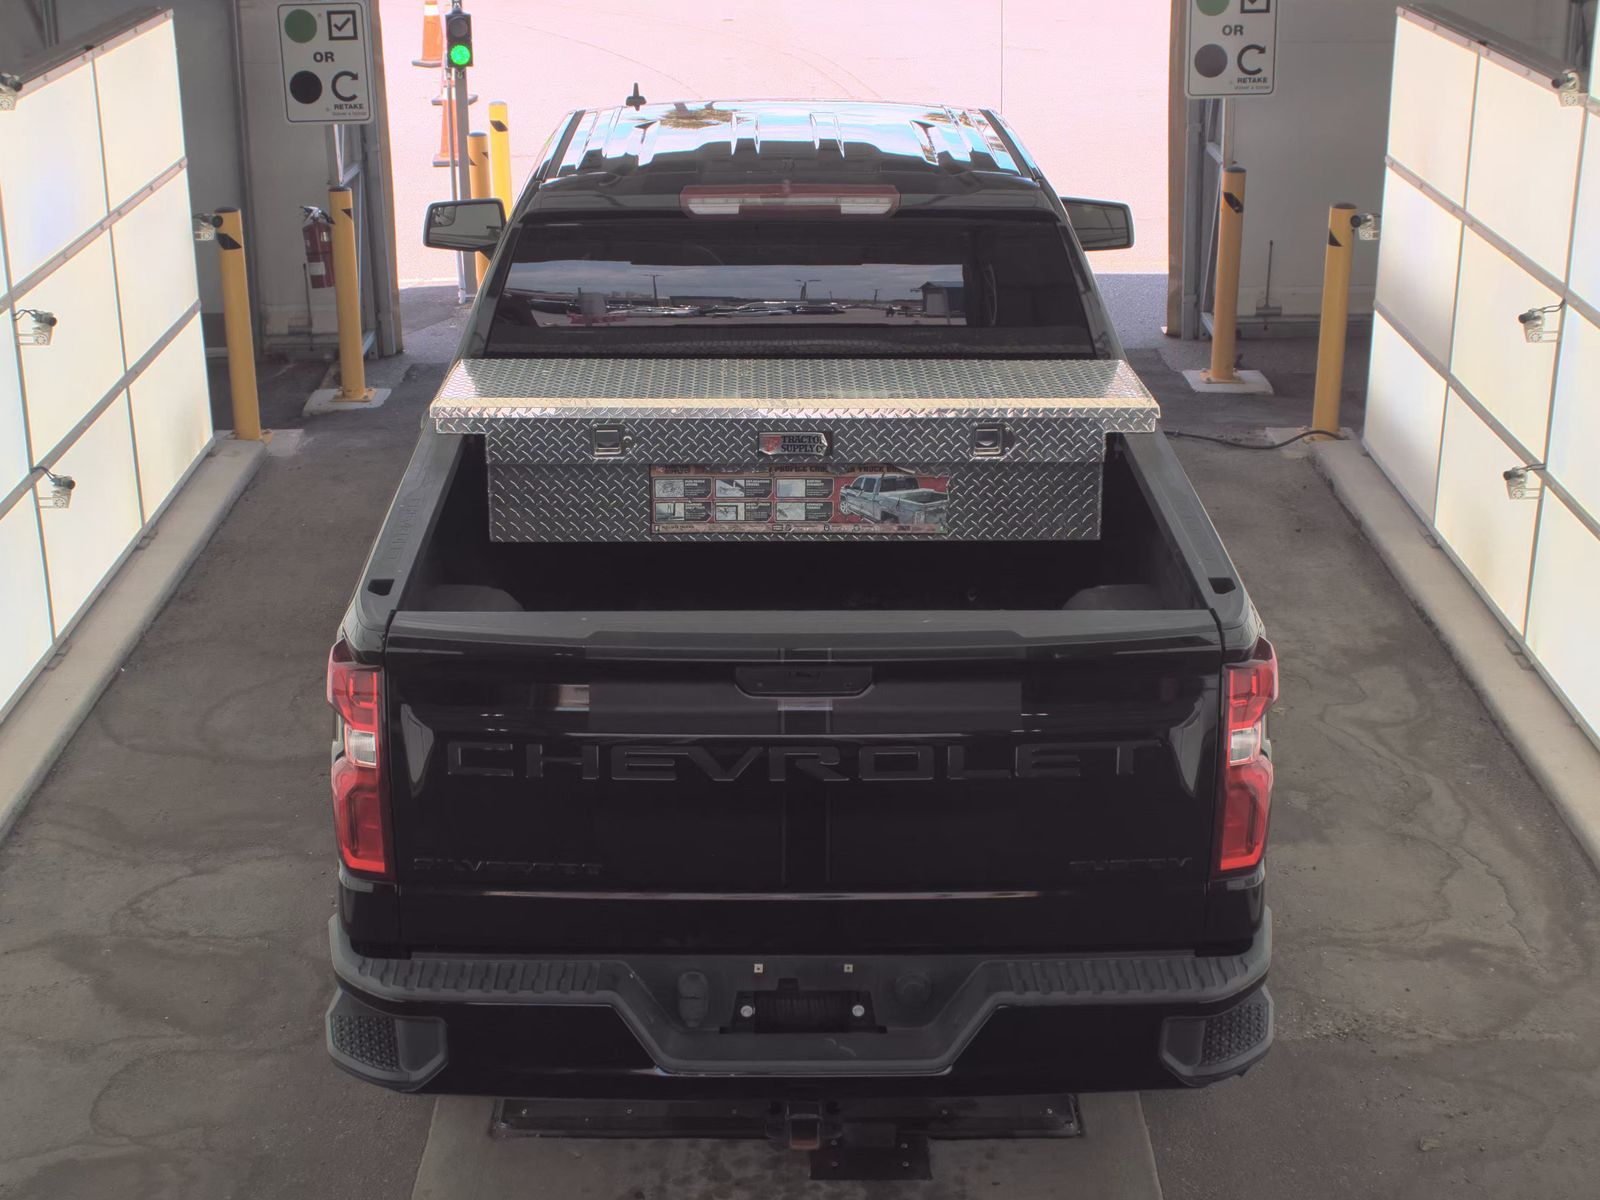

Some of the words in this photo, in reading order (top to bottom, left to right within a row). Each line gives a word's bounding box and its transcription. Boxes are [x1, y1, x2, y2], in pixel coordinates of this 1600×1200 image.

[1222, 25, 1244, 36] OR
[313, 52, 335, 62] OR
[781, 444, 815, 453] SUPPLY
[446, 740, 1162, 782] CHEVROLET
